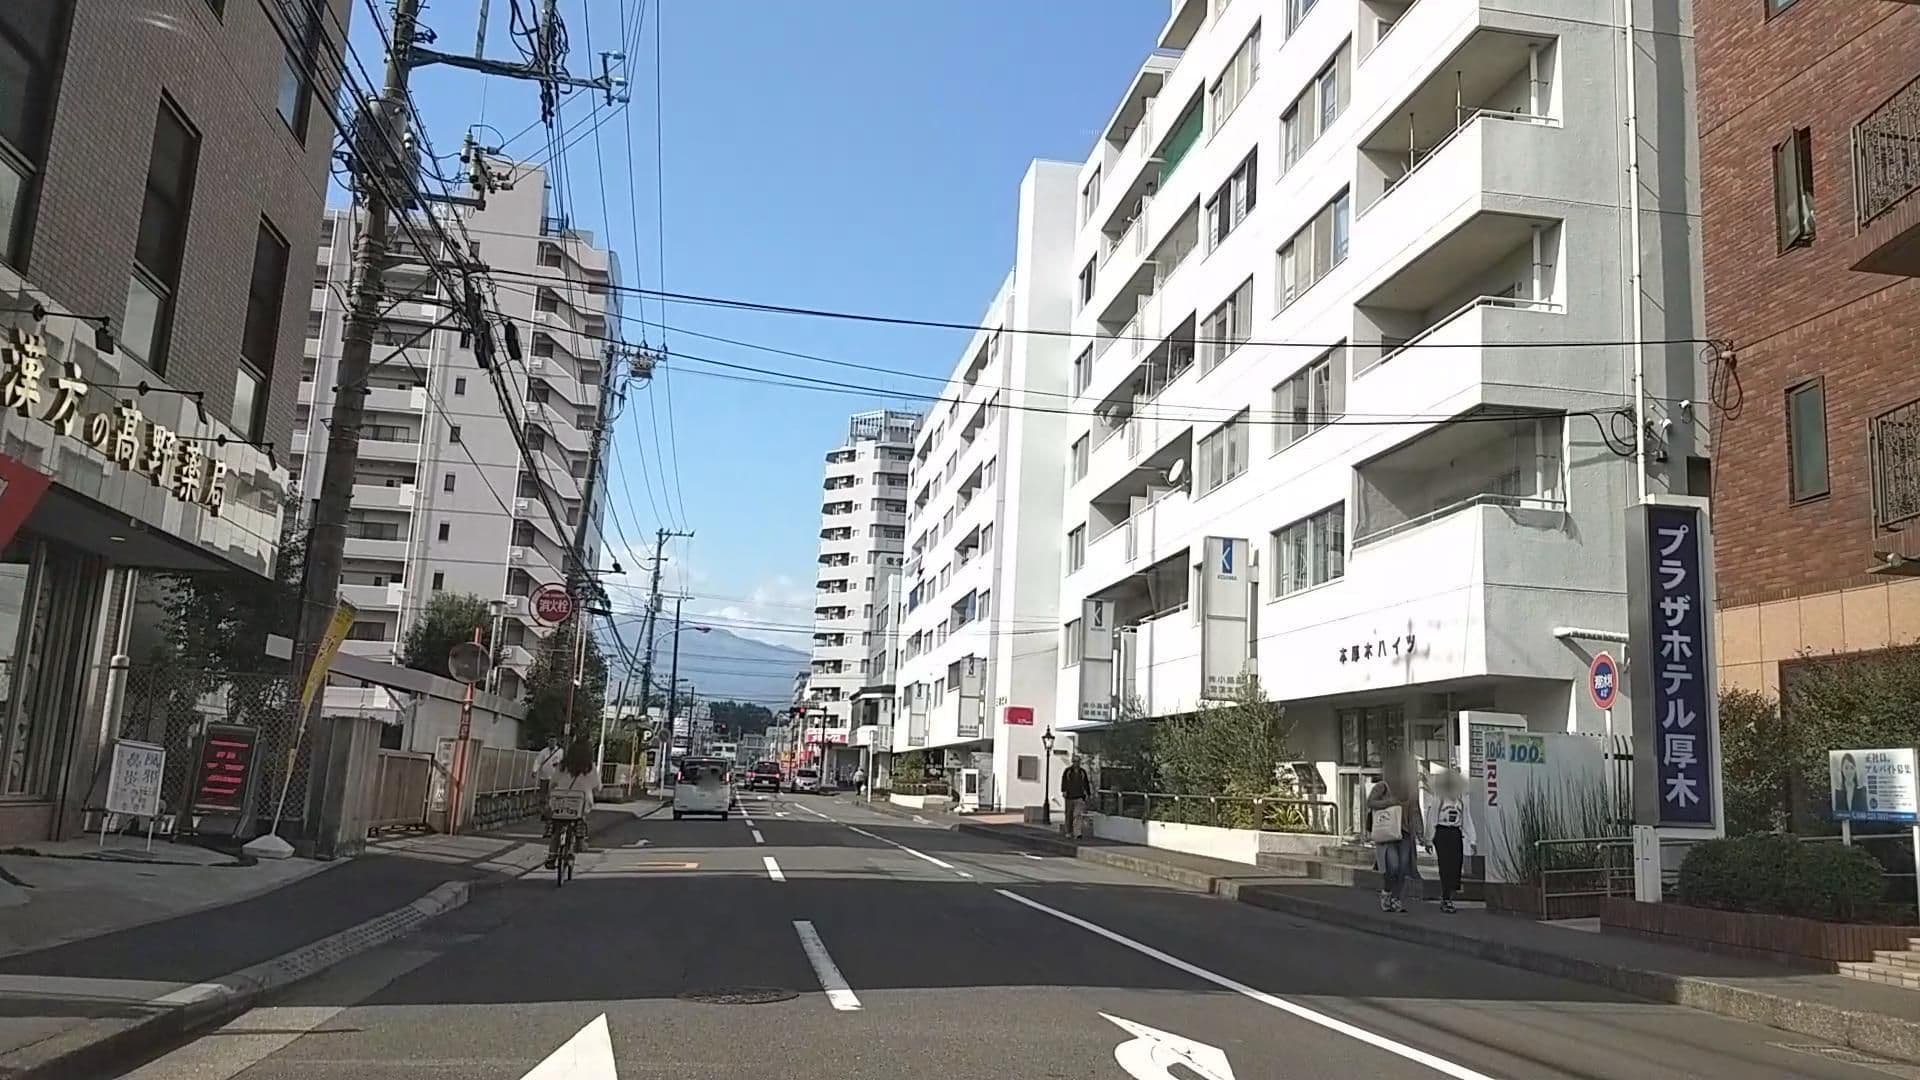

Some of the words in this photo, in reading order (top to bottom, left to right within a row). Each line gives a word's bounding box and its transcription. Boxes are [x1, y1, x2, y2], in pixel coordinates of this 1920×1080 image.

[539, 599, 569, 612] 消火栓
[1658, 524, 1699, 808] プラザホテル厚木
